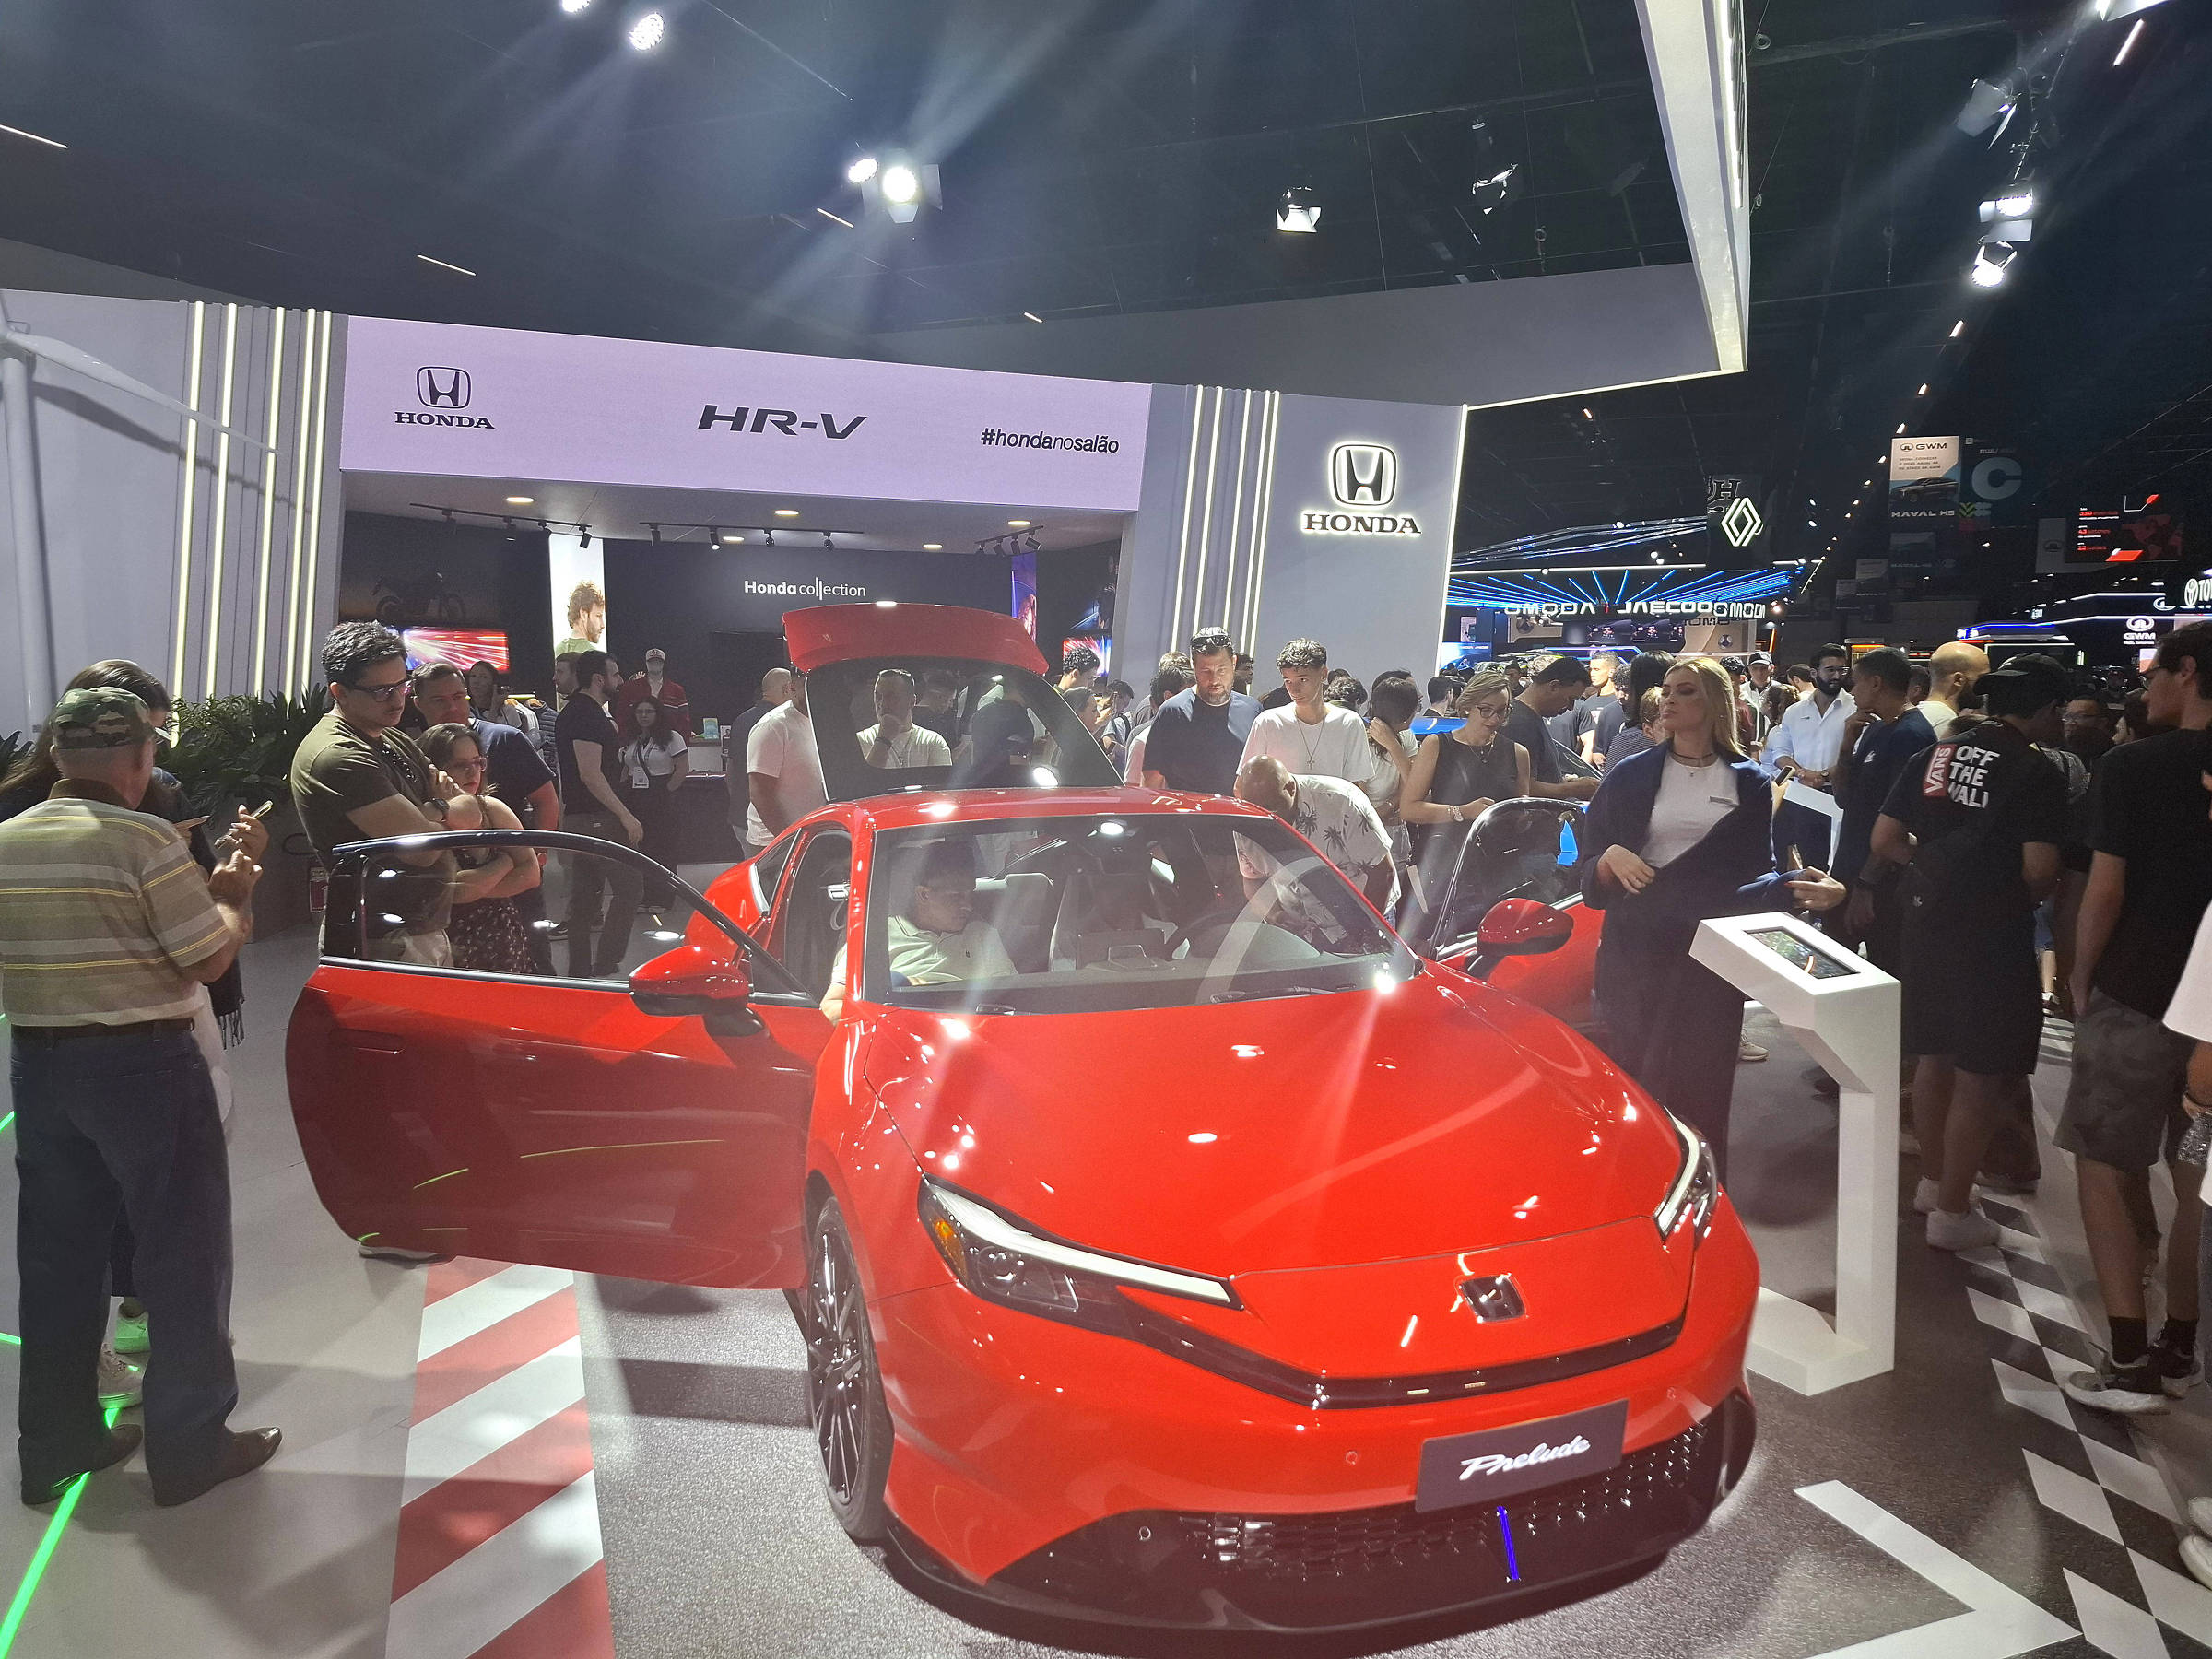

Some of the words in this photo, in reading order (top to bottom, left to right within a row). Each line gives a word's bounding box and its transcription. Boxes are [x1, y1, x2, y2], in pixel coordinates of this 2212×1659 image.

[394, 411, 496, 429] HONDA
[698, 404, 868, 440] HR-V
[981, 427, 1119, 453] #hondanosalão
[1916, 442, 1947, 451] GWM
[1303, 513, 1422, 535] HONDA
[744, 580, 796, 594] Honda
[799, 577, 866, 601] collection
[2198, 579, 2212, 601] TO
[1504, 602, 1596, 615] OMODA
[1616, 601, 1713, 614] JAECOO
[2123, 632, 2156, 641] GWM
[1956, 745, 2001, 767] OFF
[1924, 747, 1952, 794] VANS
[1948, 761, 1989, 787] THE
[1458, 1434, 1591, 1482] Prelude
